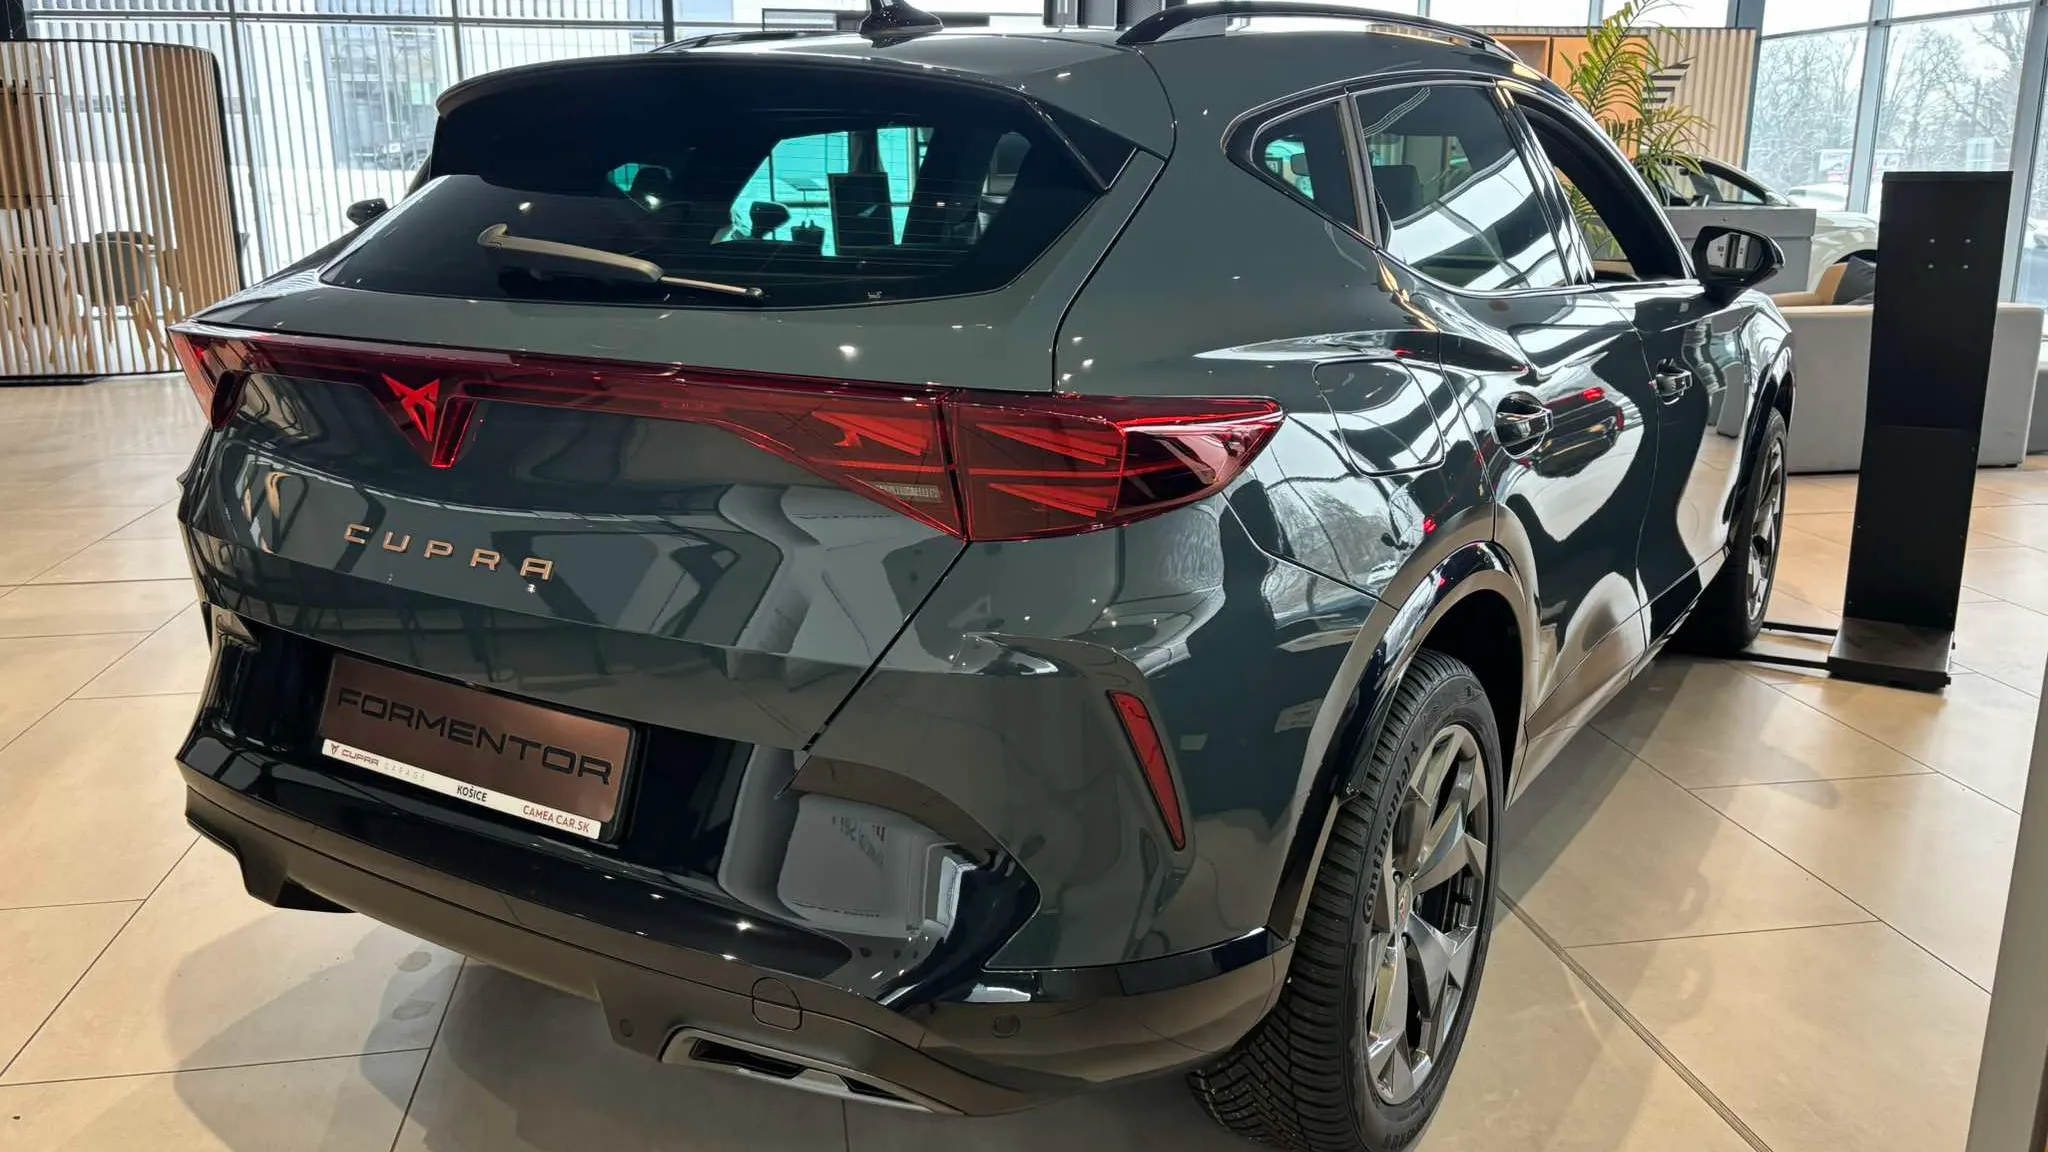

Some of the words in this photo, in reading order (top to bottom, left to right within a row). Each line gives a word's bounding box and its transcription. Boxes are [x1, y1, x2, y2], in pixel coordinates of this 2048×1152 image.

[344, 524, 555, 580] CUPRA
[337, 687, 613, 785] FORMENTOR
[341, 748, 380, 767] CUPRA
[456, 784, 488, 802] KOŠICE
